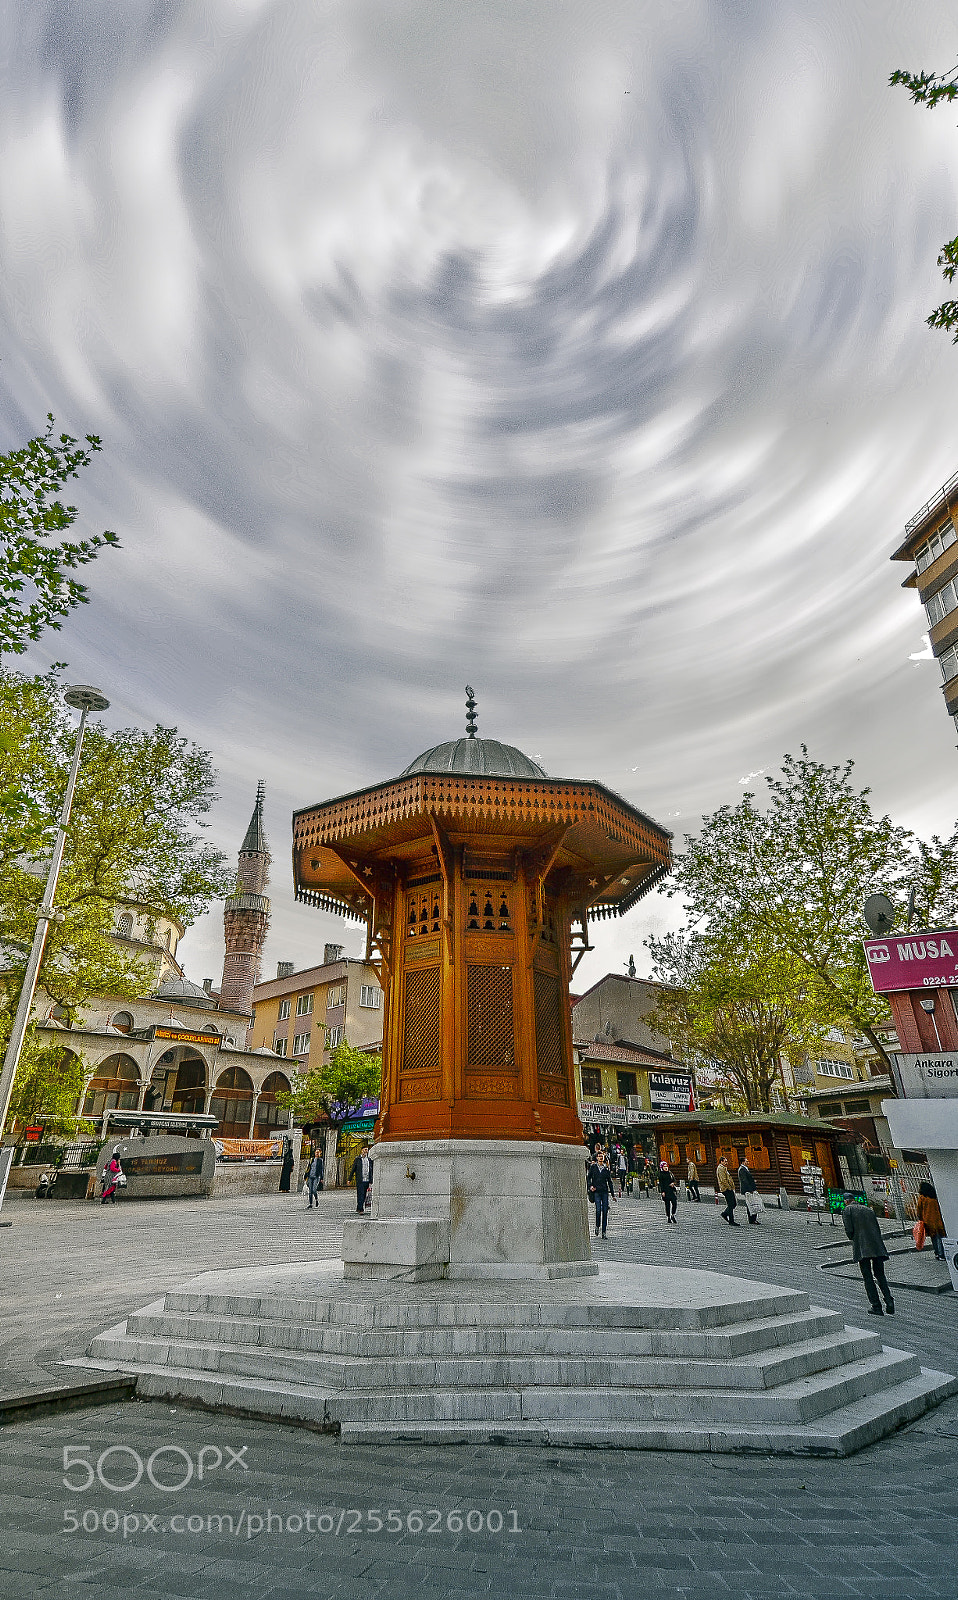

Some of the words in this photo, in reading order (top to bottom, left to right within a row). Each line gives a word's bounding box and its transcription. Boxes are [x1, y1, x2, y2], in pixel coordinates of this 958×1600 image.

[896, 939, 954, 961] MUSA
[923, 976, 947, 986] 0224
[915, 1060, 954, 1068] Ankara
